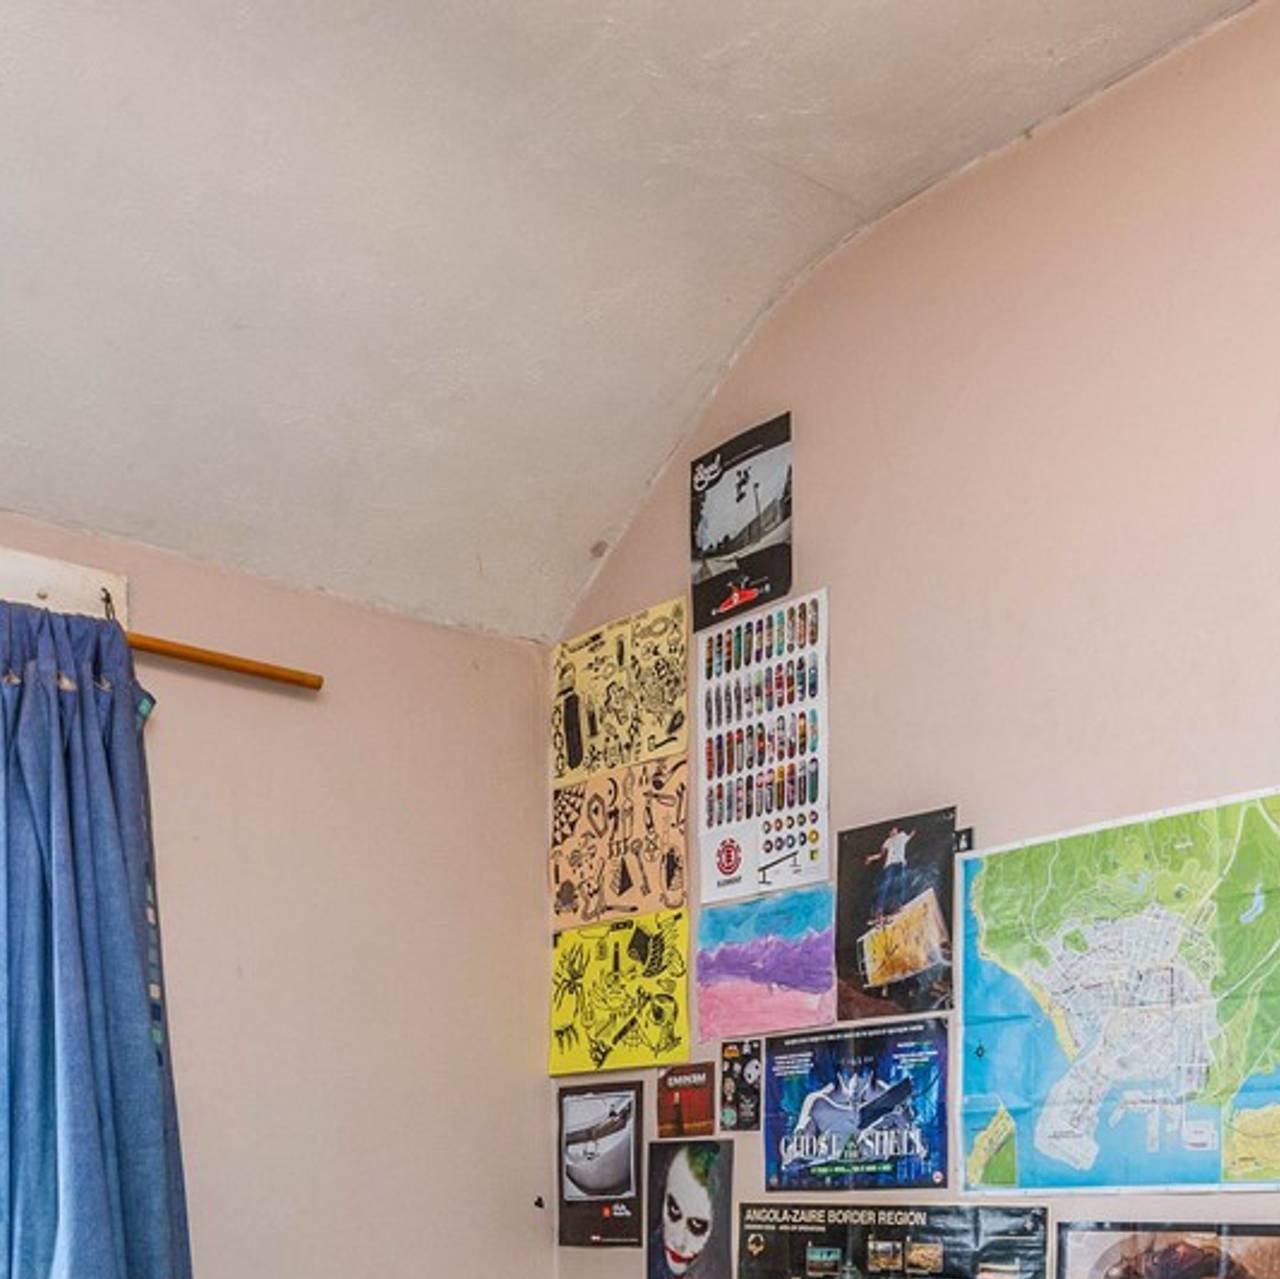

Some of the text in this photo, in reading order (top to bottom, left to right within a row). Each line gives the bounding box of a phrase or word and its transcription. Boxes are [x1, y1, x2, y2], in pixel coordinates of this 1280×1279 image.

[745, 1209, 927, 1226] ANGOLA-ZAIRE BORDER REGION
